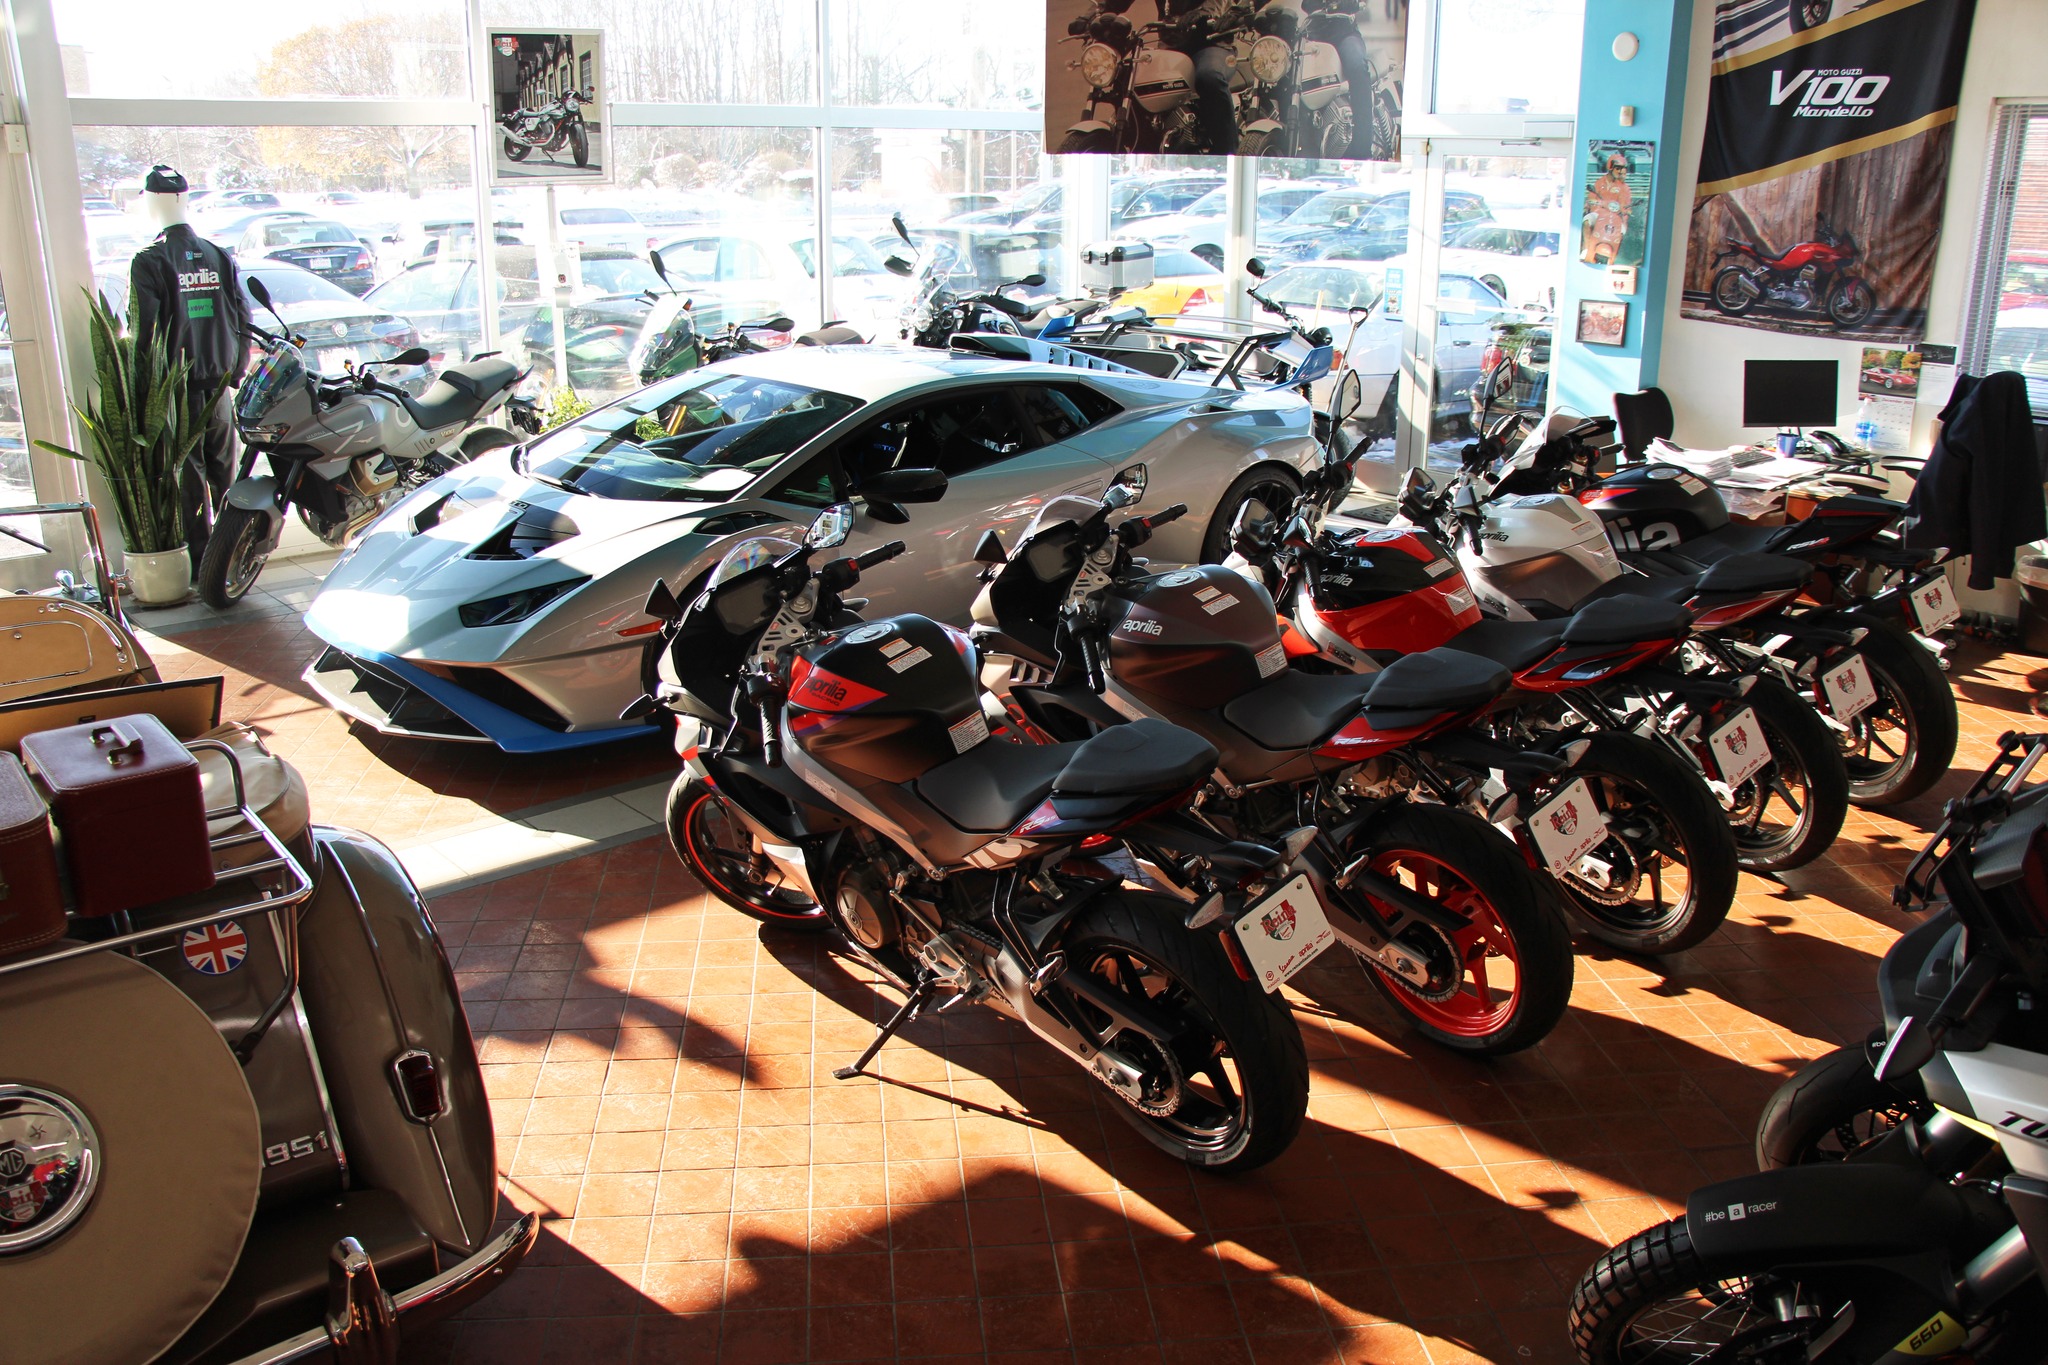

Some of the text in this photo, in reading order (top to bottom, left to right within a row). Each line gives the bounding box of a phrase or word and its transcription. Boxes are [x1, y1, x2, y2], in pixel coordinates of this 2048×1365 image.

[1840, 68, 1863, 76] GUZZI
[1769, 69, 1890, 106] V100
[1792, 106, 1874, 118] Mandello
[178, 268, 220, 288] aprilia
[1122, 619, 1163, 636] aprilia
[805, 677, 848, 702] aprilia
[1260, 905, 1296, 936] Reina
[1298, 942, 1314, 957] aprilia
[260, 1130, 329, 1168] 951
[1704, 1210, 1726, 1222] #be
[1747, 1201, 1777, 1213] racer
[1909, 1318, 1944, 1352] 660
